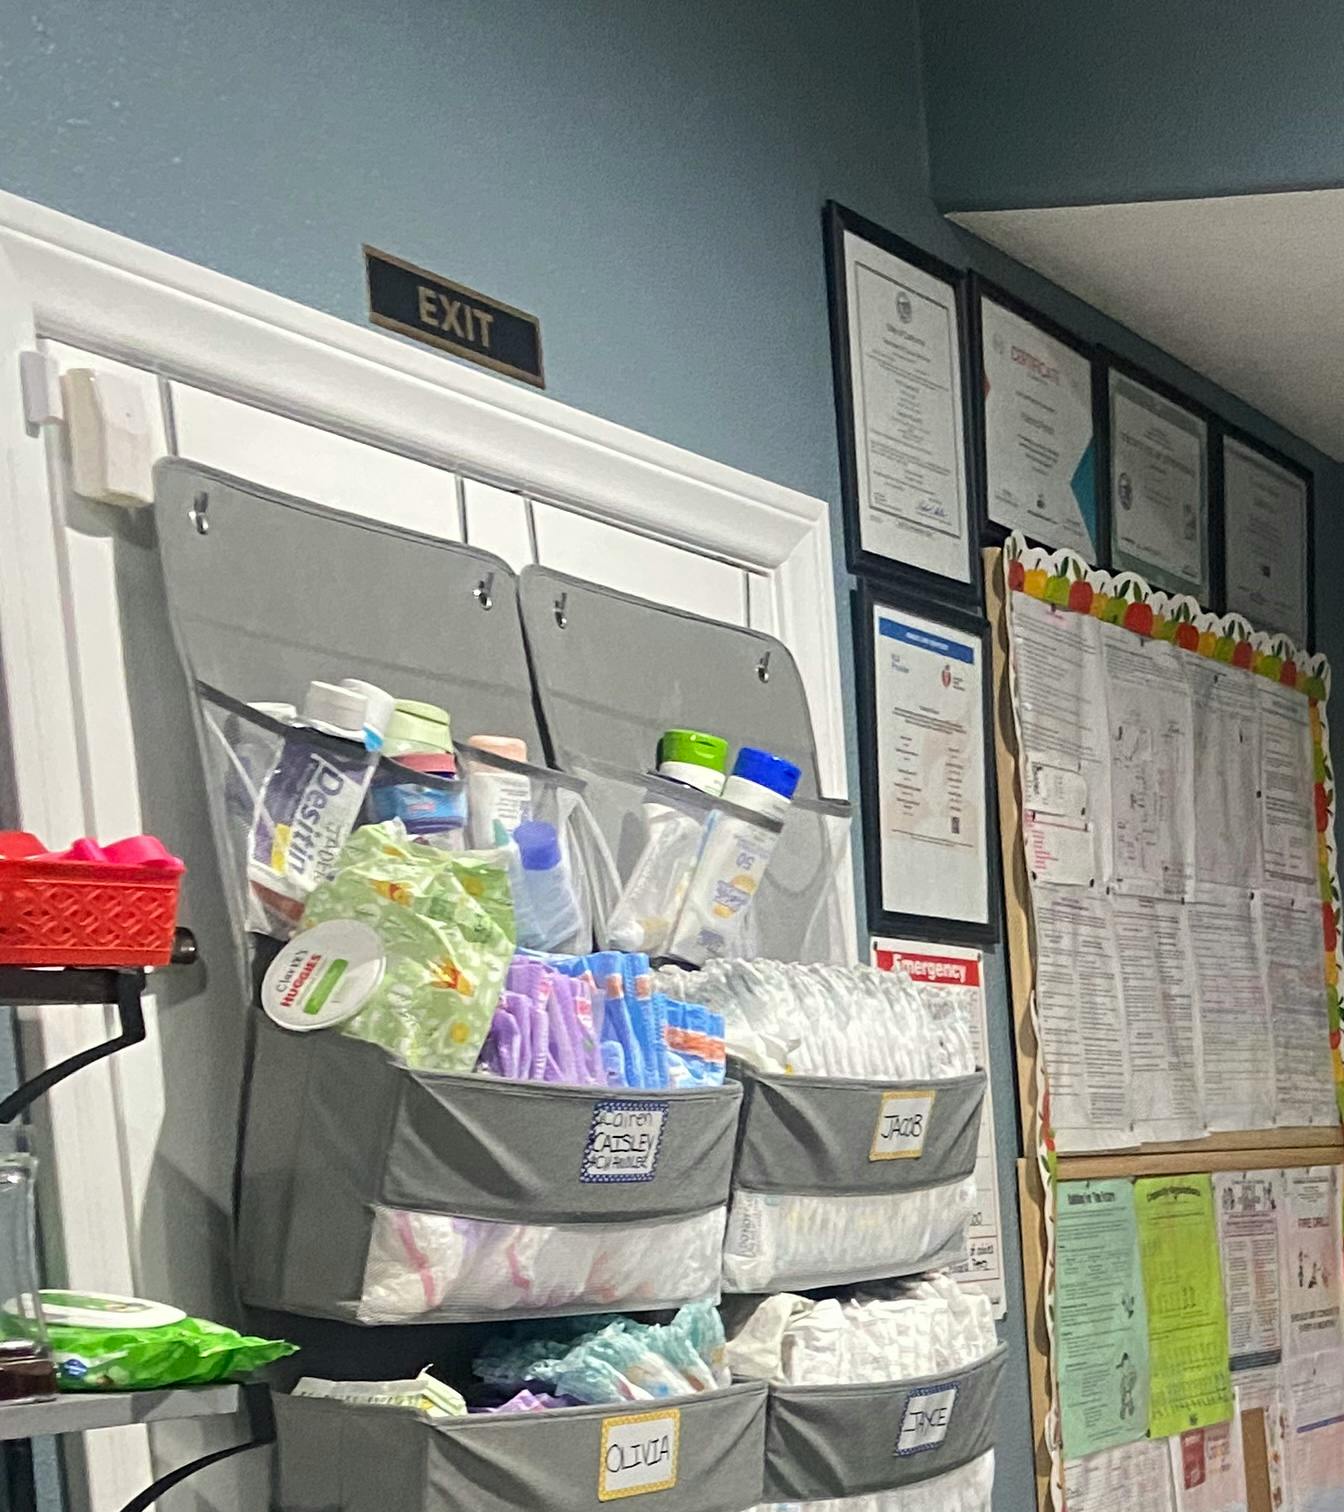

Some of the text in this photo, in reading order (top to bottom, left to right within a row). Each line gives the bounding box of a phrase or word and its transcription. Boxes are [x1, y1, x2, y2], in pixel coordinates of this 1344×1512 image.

[417, 286, 494, 350] EXIT
[287, 753, 345, 876] Desitin
[279, 953, 324, 1008] HUGGIES
[892, 953, 967, 981] Emergency
[606, 1435, 670, 1473] OLIVIA
